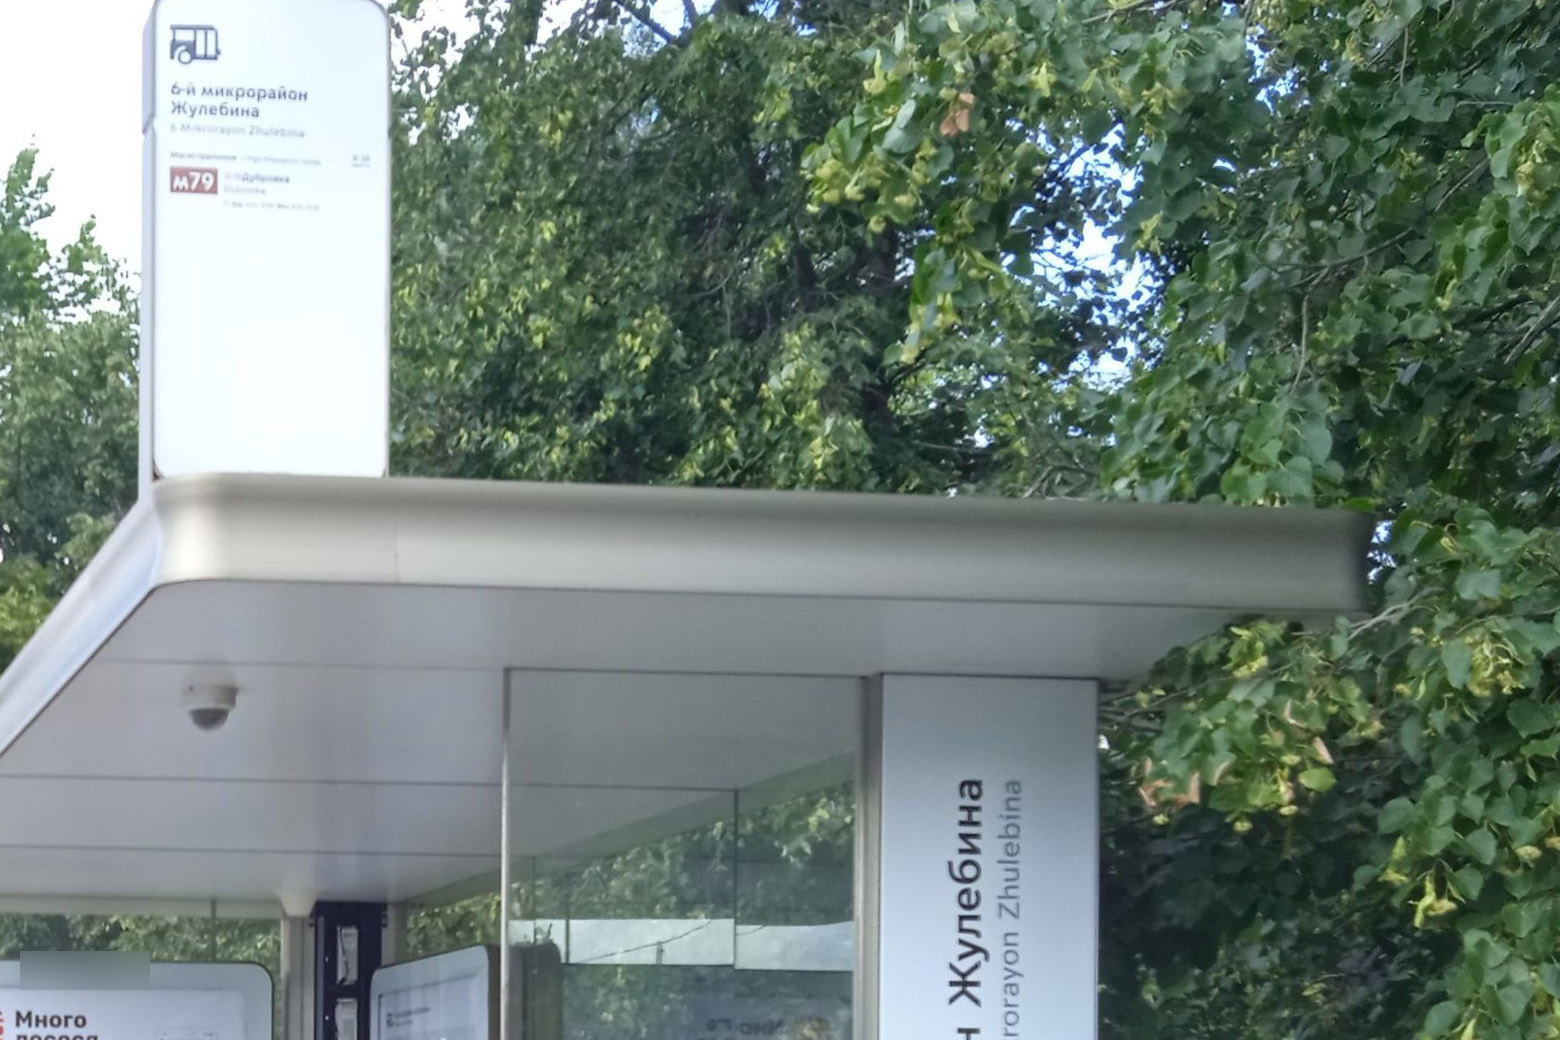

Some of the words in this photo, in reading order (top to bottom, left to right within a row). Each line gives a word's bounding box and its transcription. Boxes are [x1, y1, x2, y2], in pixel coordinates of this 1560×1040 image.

[170, 81, 197, 96] 6-й
[201, 85, 308, 102] микрорайон
[170, 100, 260, 118] Жулебина
[996, 779, 1023, 920] Zhulebina
[947, 778, 990, 1008] Жулебина
[14, 1009, 88, 1029] Много
